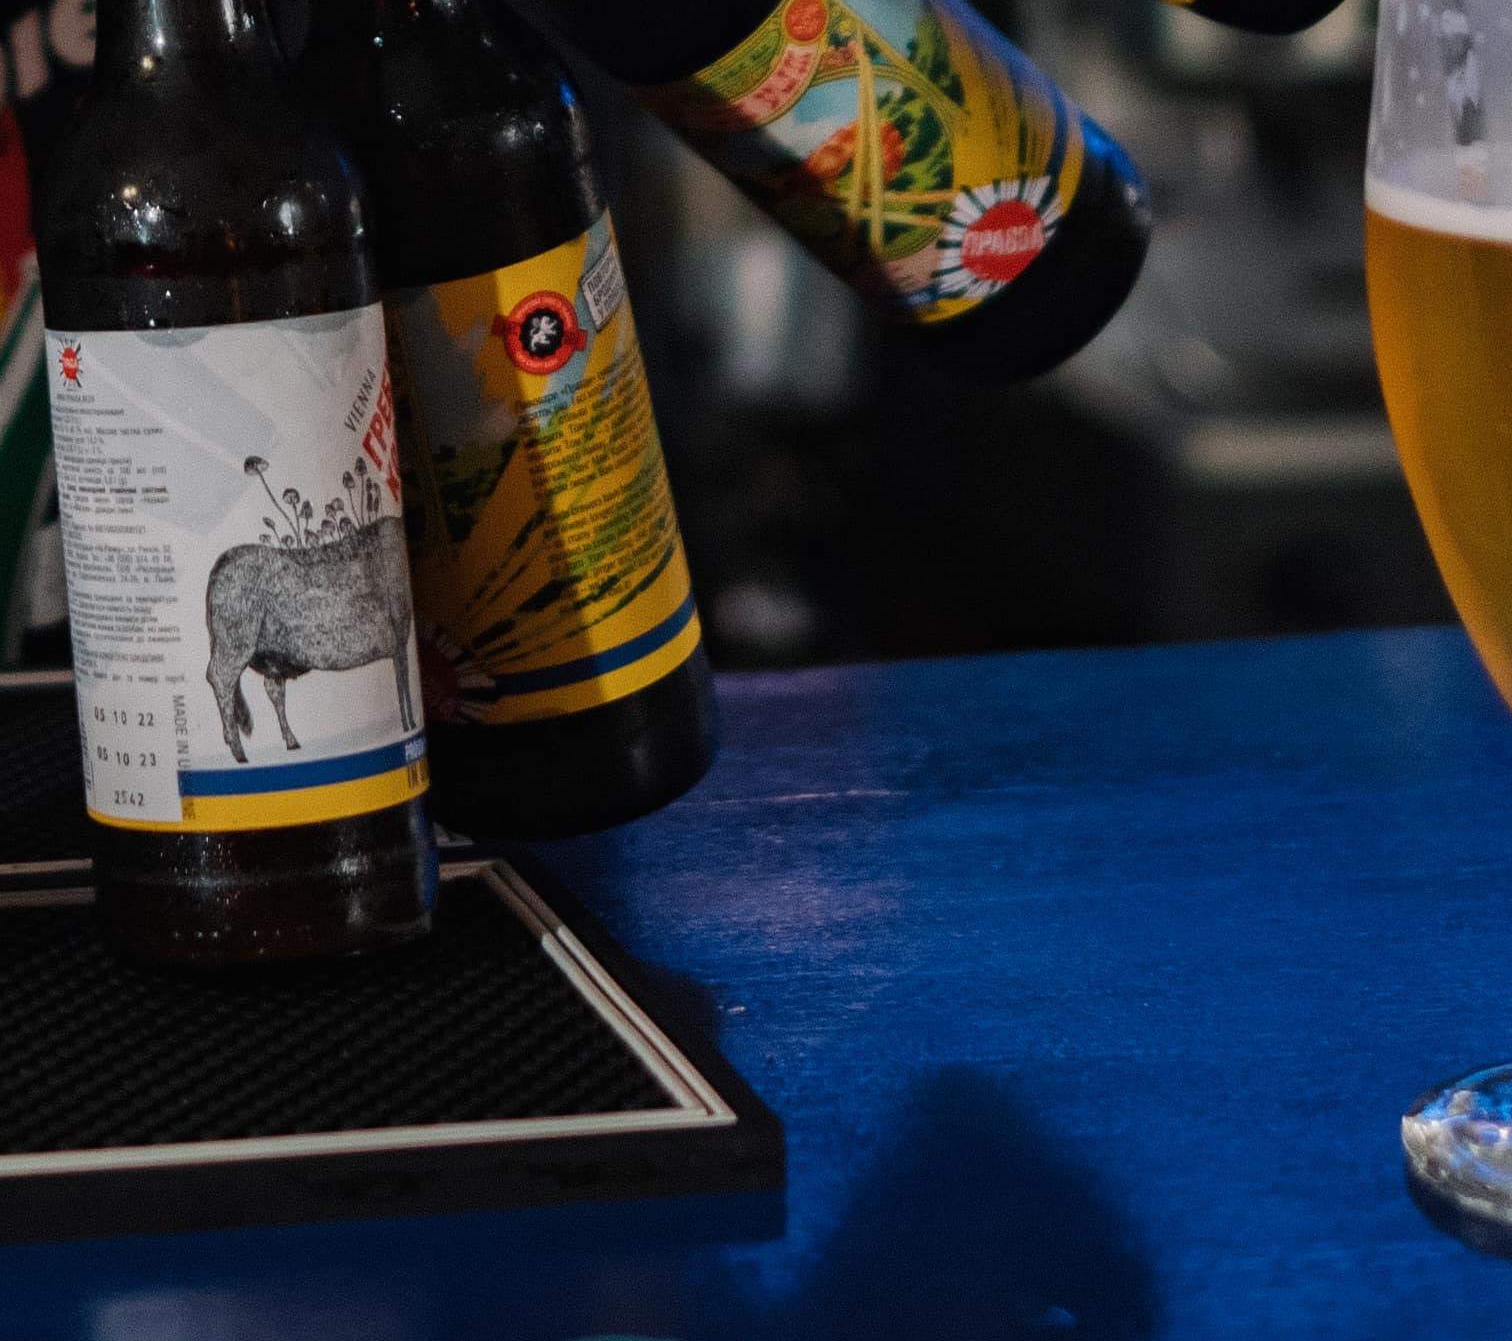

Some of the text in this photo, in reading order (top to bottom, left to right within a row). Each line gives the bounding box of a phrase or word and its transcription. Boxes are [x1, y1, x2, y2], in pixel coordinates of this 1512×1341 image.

[344, 368, 376, 433] VIENNA
[94, 706, 154, 726] 05 10 22
[173, 695, 188, 735] MADE
[97, 745, 156, 766] 05 10 23
[177, 740, 189, 754] IN
